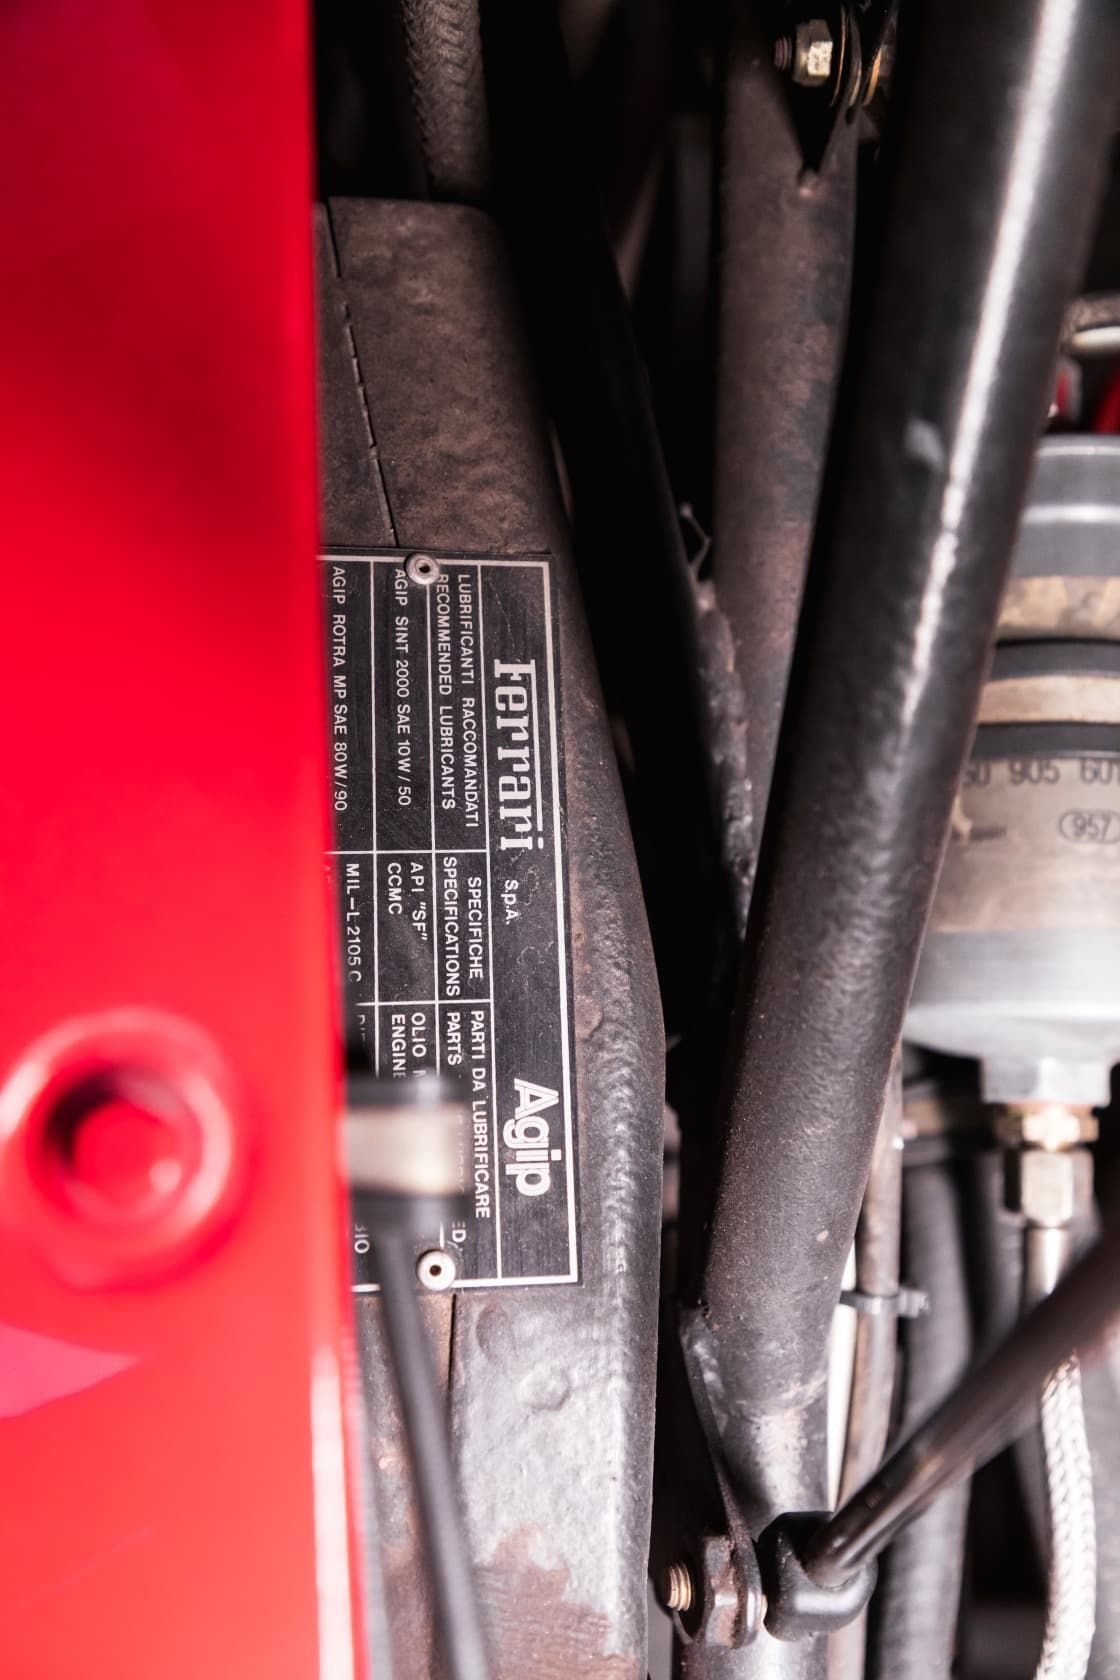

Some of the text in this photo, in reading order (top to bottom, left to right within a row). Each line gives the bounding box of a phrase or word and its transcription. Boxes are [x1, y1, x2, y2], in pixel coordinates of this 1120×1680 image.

[332, 566, 346, 604] AGIP
[394, 569, 408, 606] AGIP
[332, 614, 346, 667] ROTRA
[395, 616, 409, 653] SINT
[333, 675, 347, 699] MP
[396, 660, 410, 698] 2000
[436, 574, 455, 810] RECOMMENDED LUBRICANTS
[458, 574, 479, 827] LUBRIFICANTI RACCOMANDATI
[334, 704, 348, 735] SAE
[397, 707, 411, 734] SAE
[494, 659, 543, 925] Ferrari S.p.A.
[388, 862, 402, 915] CCMC
[410, 862, 428, 941] API "SF"
[443, 857, 460, 997] SPECIFICATIONS
[468, 877, 484, 979] SPECIFICHE
[411, 1012, 426, 1058] OLIO
[447, 1012, 461, 1066] PARTS
[470, 1010, 490, 1219] PARTI DA LUBRIFICARE
[503, 1078, 562, 1196] Agip
